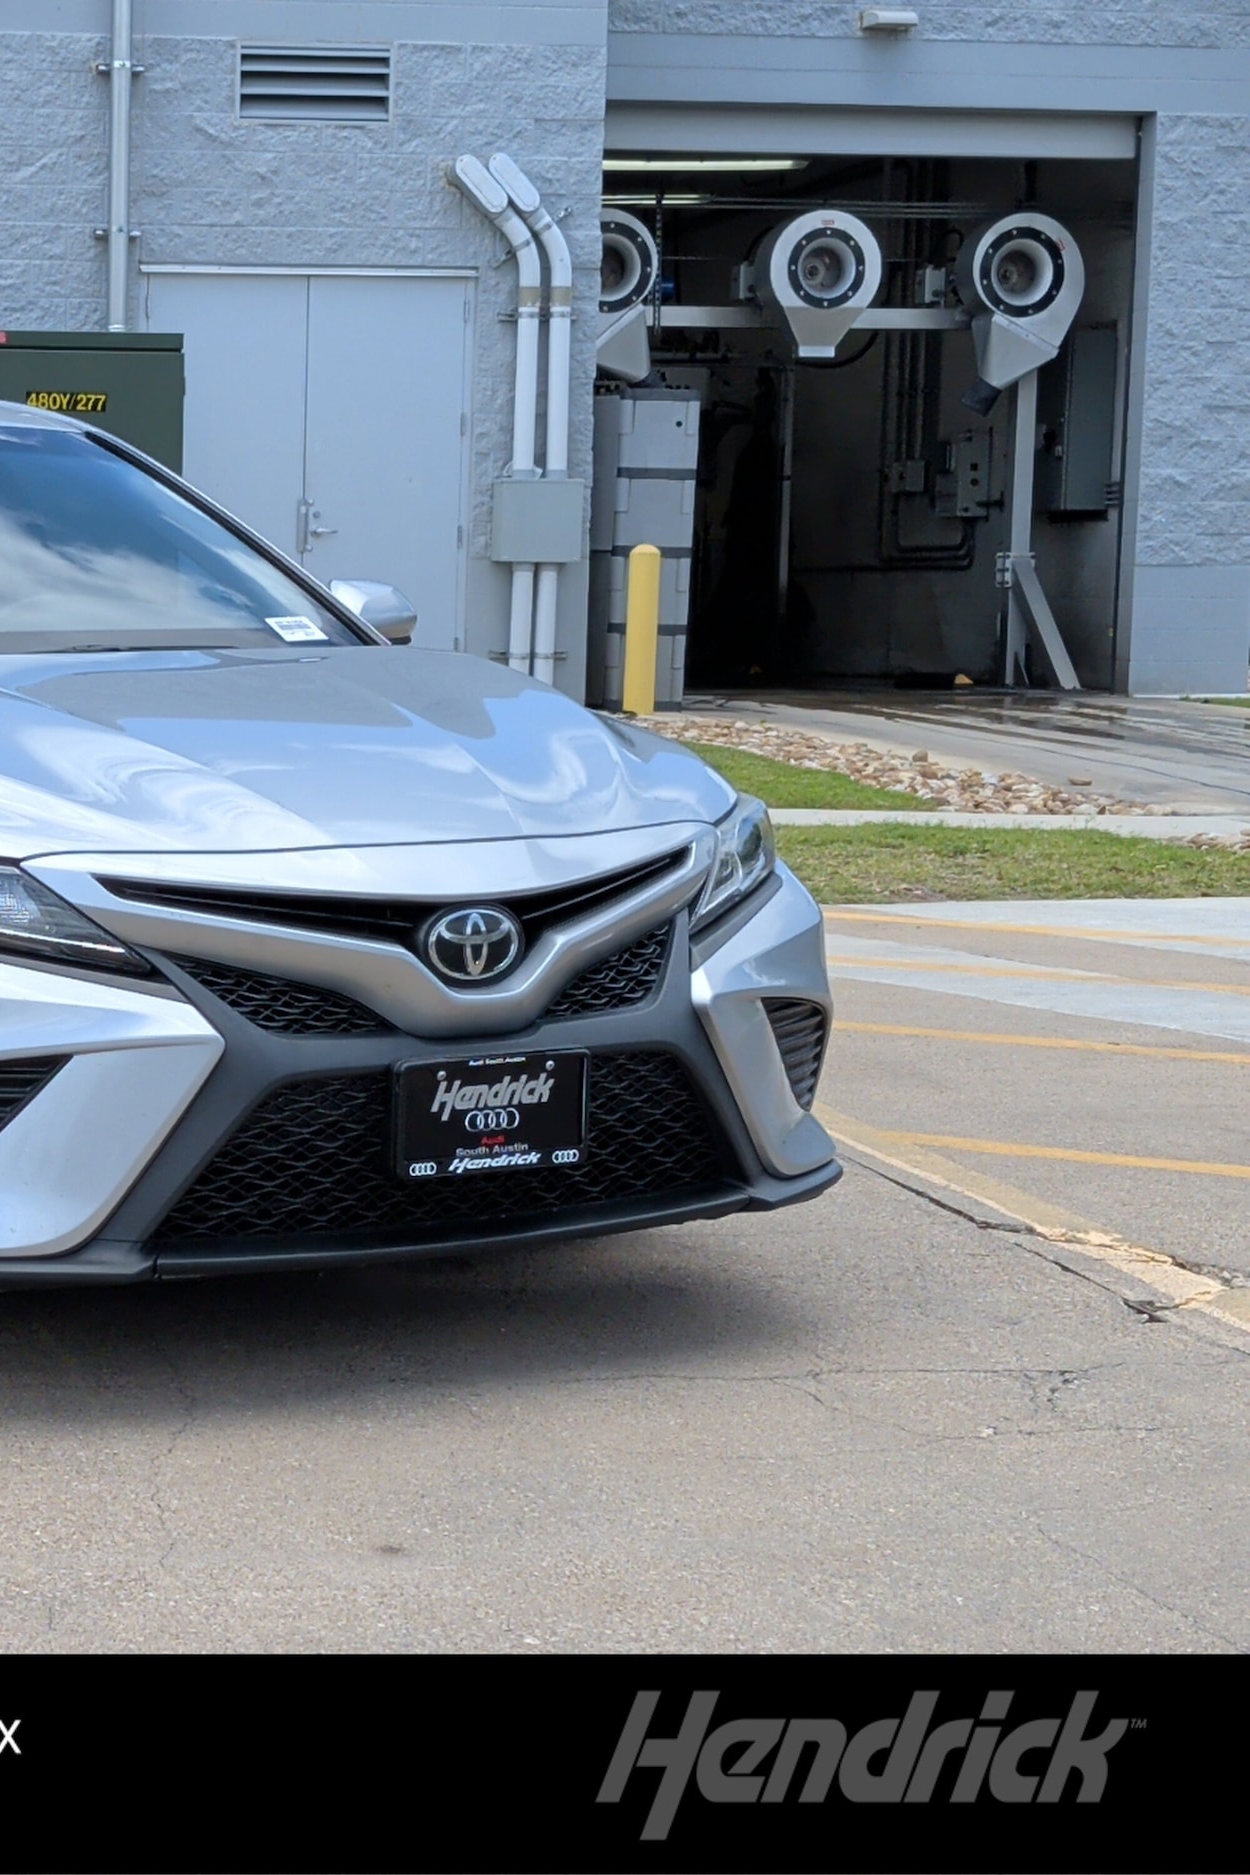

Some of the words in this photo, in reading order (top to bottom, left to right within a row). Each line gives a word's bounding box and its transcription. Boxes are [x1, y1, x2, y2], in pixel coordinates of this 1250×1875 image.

[27, 392, 106, 411] 480Y/277
[430, 1072, 555, 1121] Hendrick
[455, 1146, 489, 1157] South
[492, 1142, 529, 1154] Austin
[481, 1135, 505, 1145] Audi
[448, 1151, 542, 1174] Hendrick
